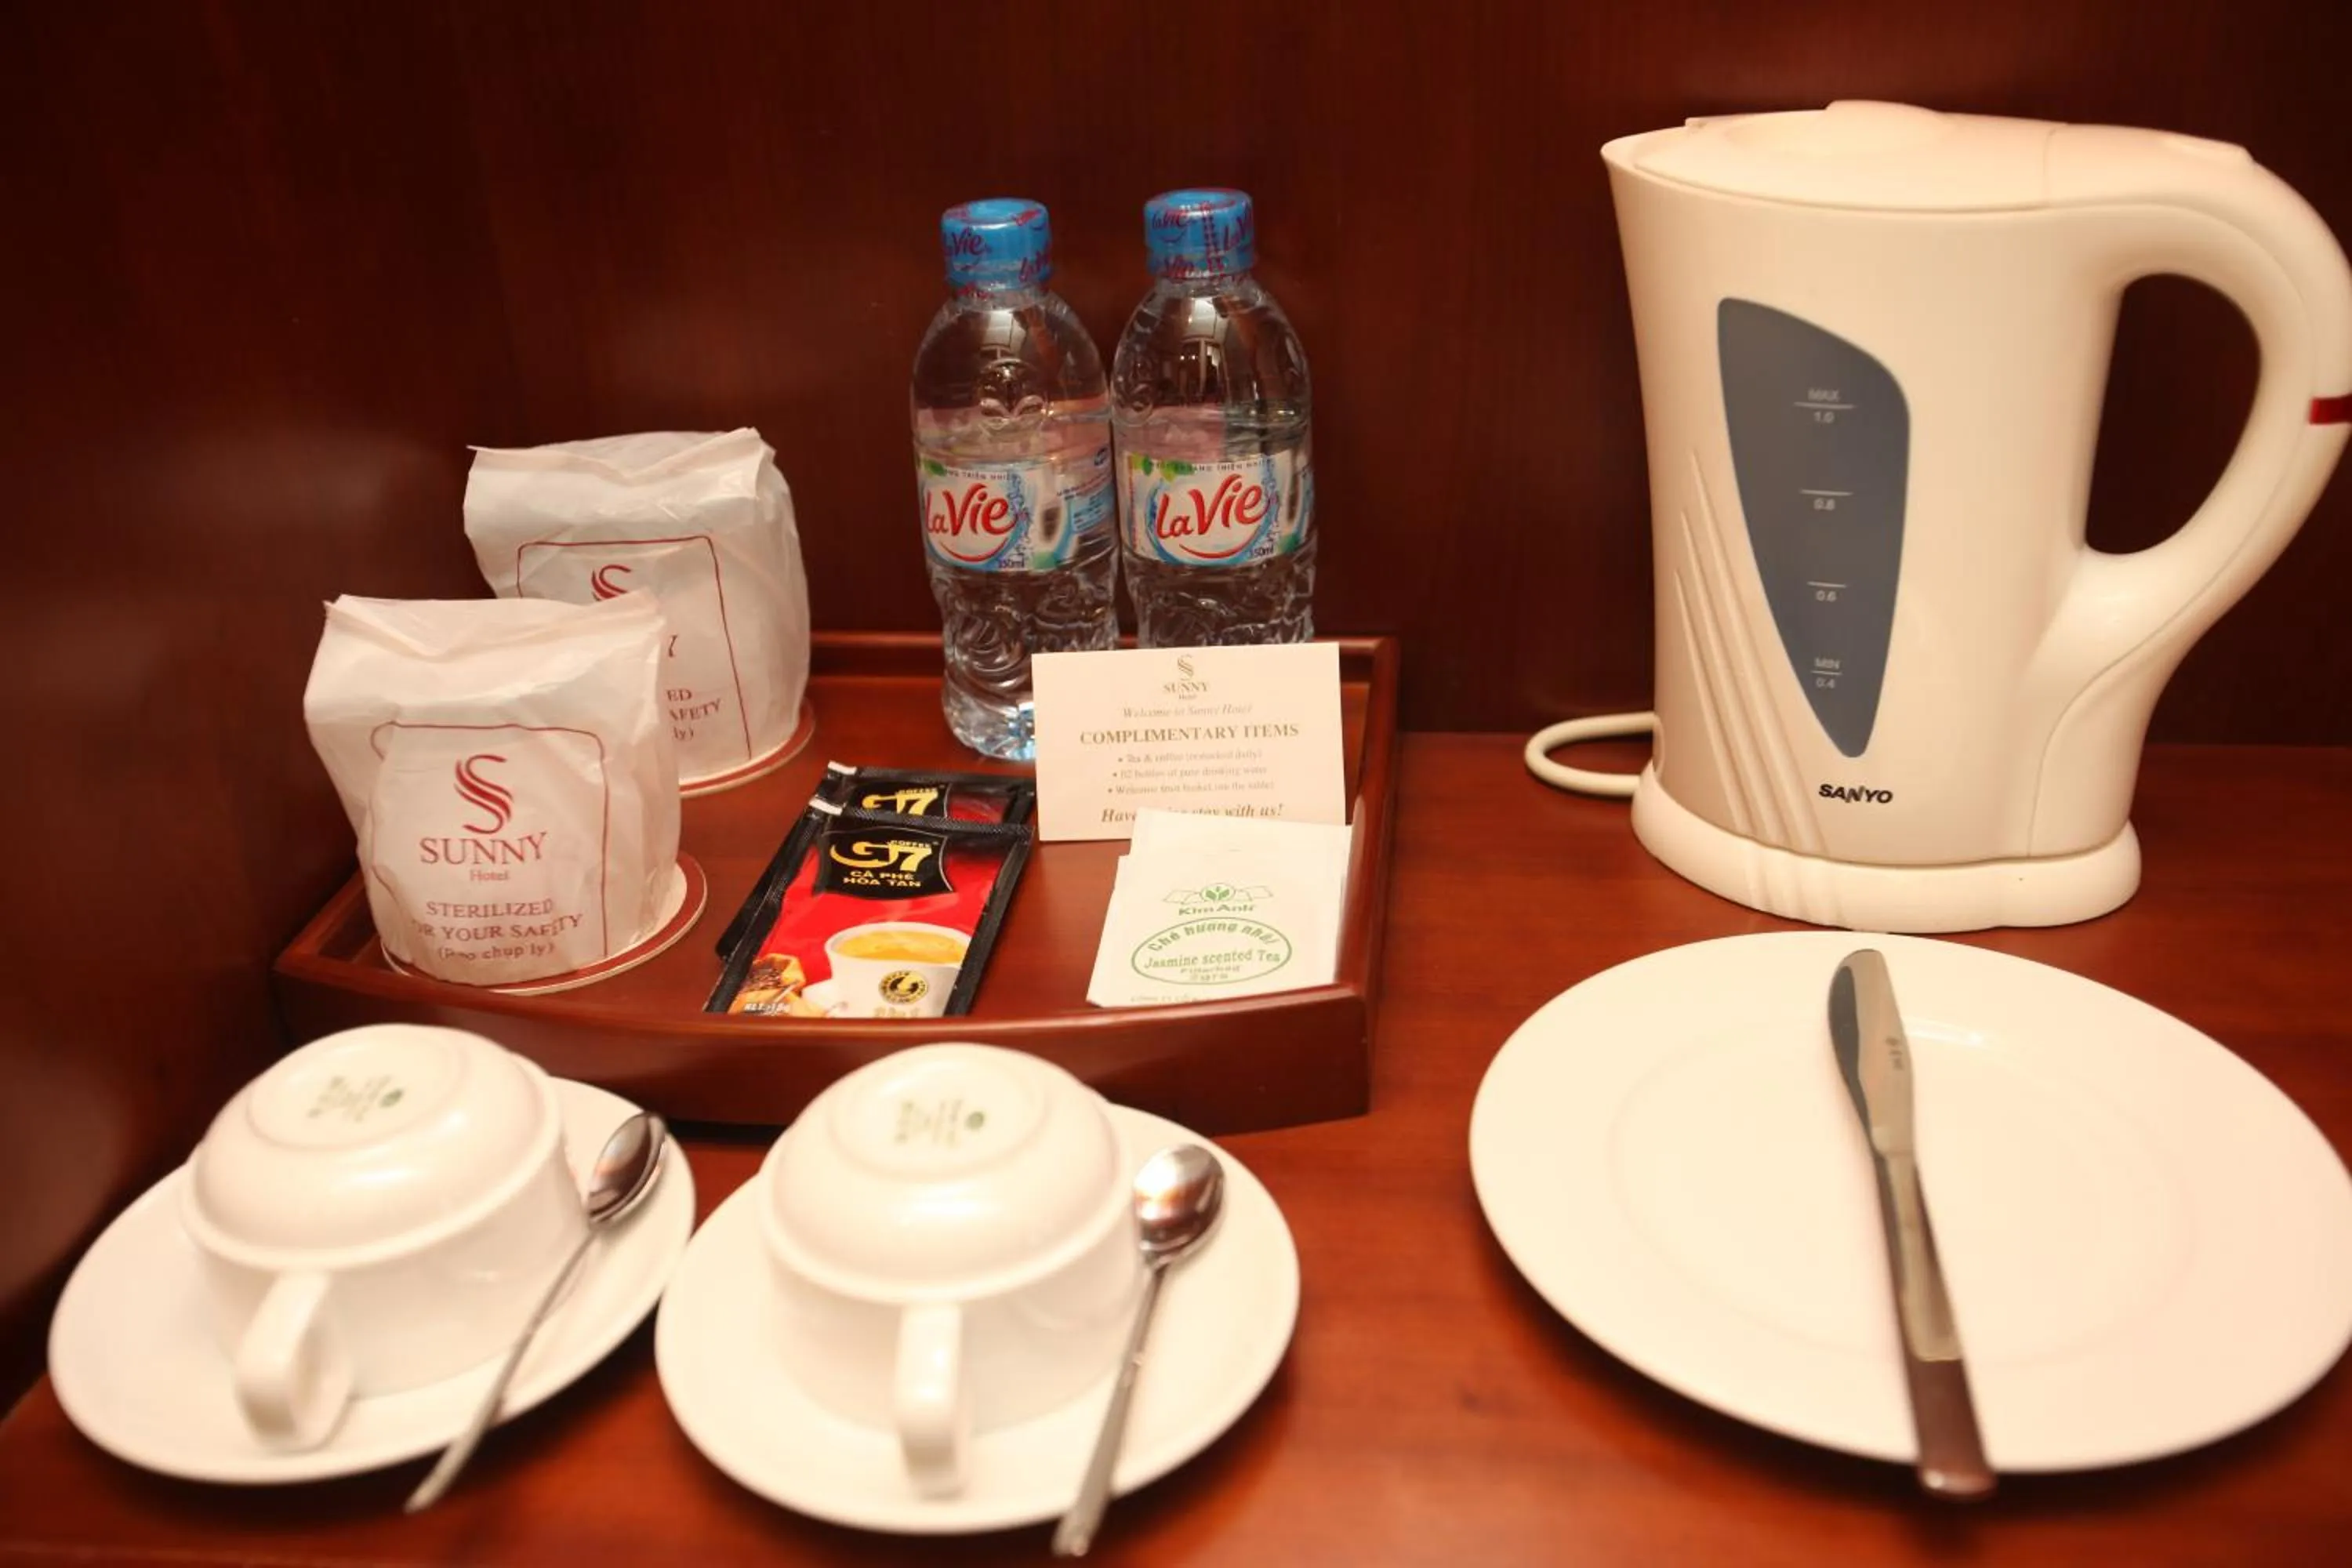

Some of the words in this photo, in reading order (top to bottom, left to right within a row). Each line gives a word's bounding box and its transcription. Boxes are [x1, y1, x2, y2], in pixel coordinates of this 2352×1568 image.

[1815, 590, 1837, 602] 0.6
[1163, 681, 1210, 694] SUNNY
[1080, 726, 1239, 745] COMPLIMENTARY
[1243, 723, 1300, 739] ITEMS
[1819, 783, 1893, 804] SANYO
[419, 832, 549, 866] SUNNY
[470, 869, 510, 881] Hotel
[887, 879, 921, 887] TAN
[425, 898, 554, 919] STERILIZED
[441, 925, 504, 942] YOUR
[510, 913, 584, 939] SAFETY
[1144, 954, 1199, 970] Jasmine
[1201, 948, 1253, 965] scented
[1257, 949, 1281, 963] Tea
